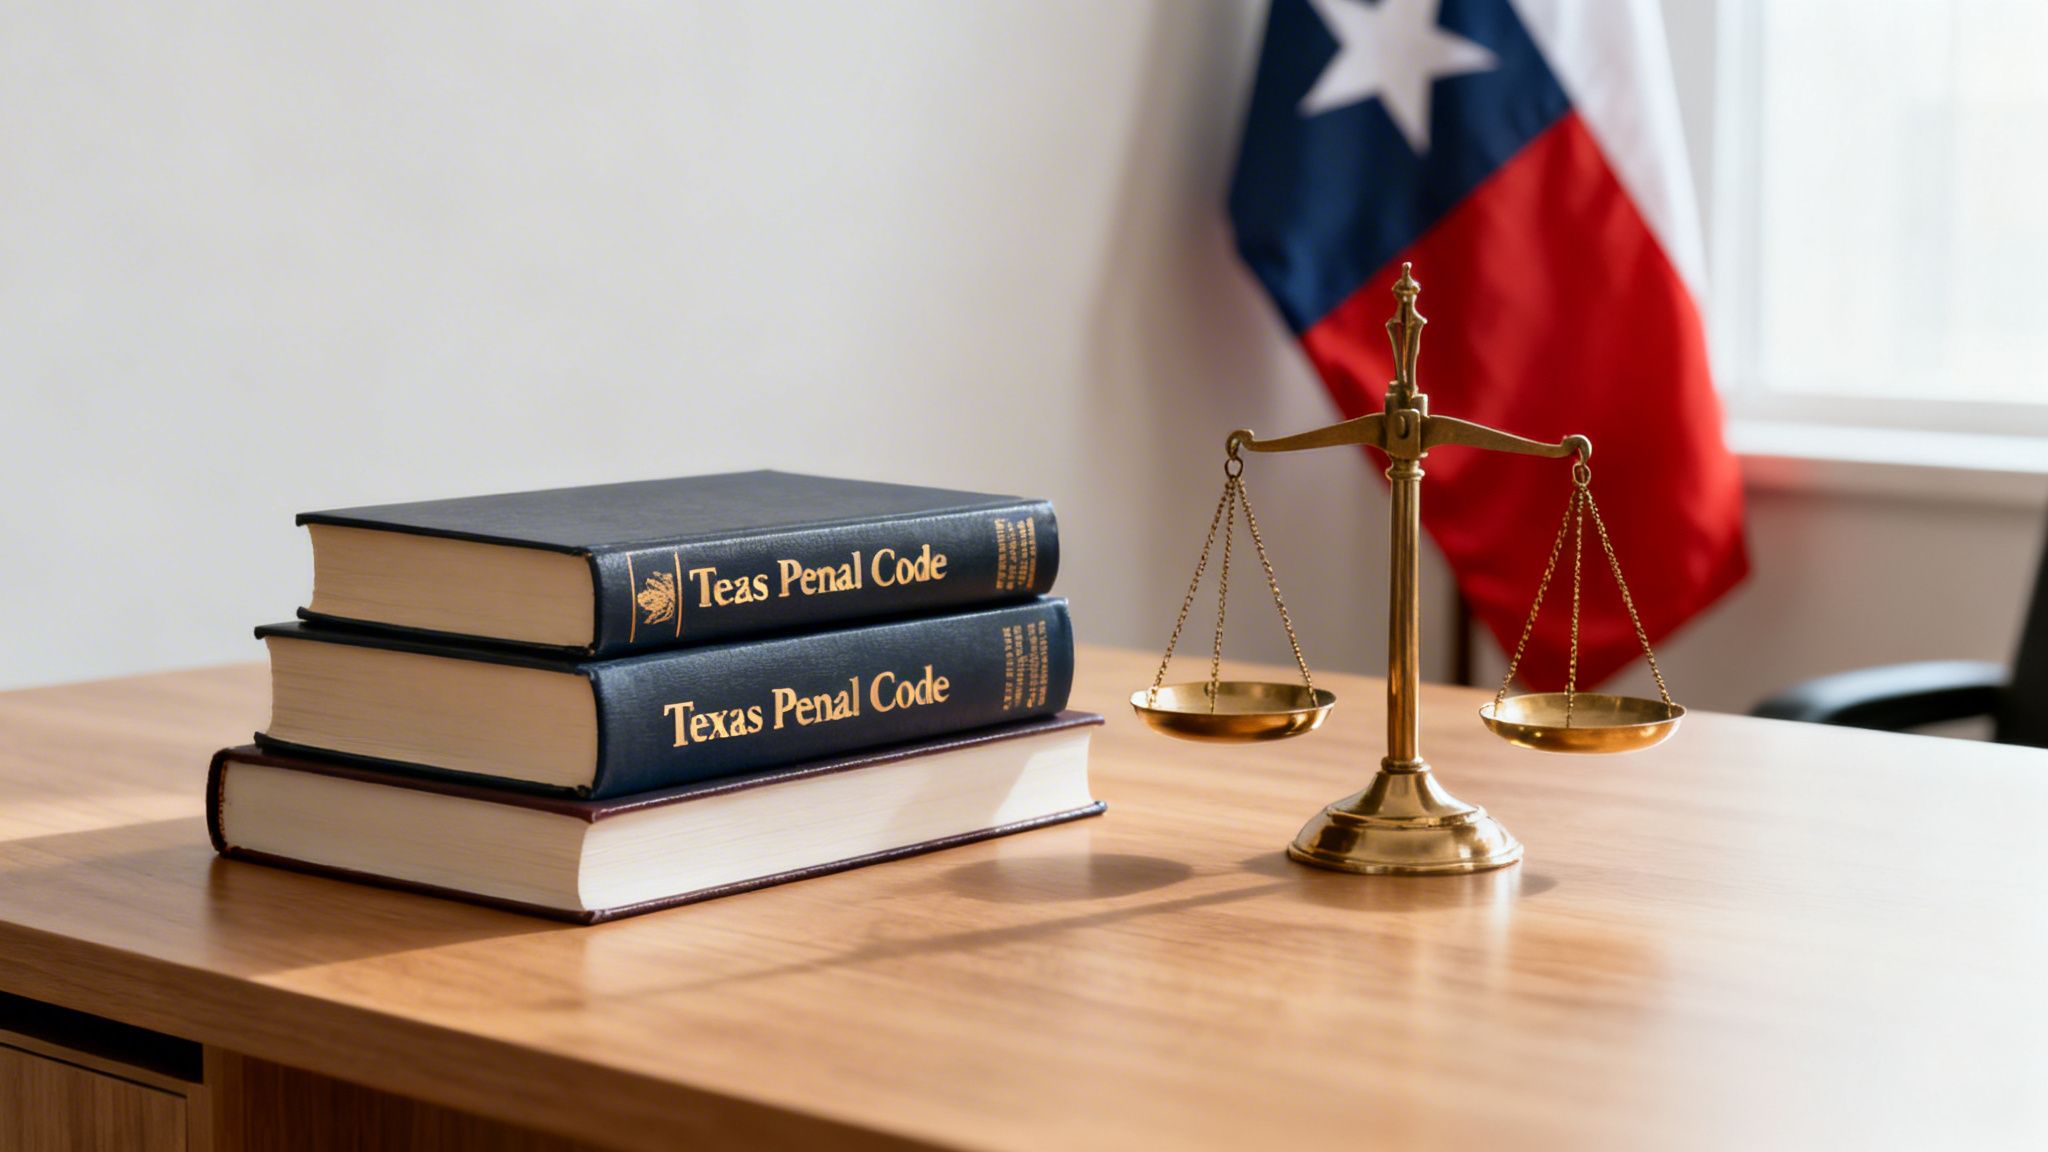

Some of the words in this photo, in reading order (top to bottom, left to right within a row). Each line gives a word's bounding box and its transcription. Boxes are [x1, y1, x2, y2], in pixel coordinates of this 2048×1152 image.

[689, 567, 769, 608] Teas
[778, 552, 862, 598] Penal
[871, 544, 948, 588] Code
[663, 701, 763, 747] Texas
[772, 676, 860, 730] Penal
[870, 664, 950, 713] Code
